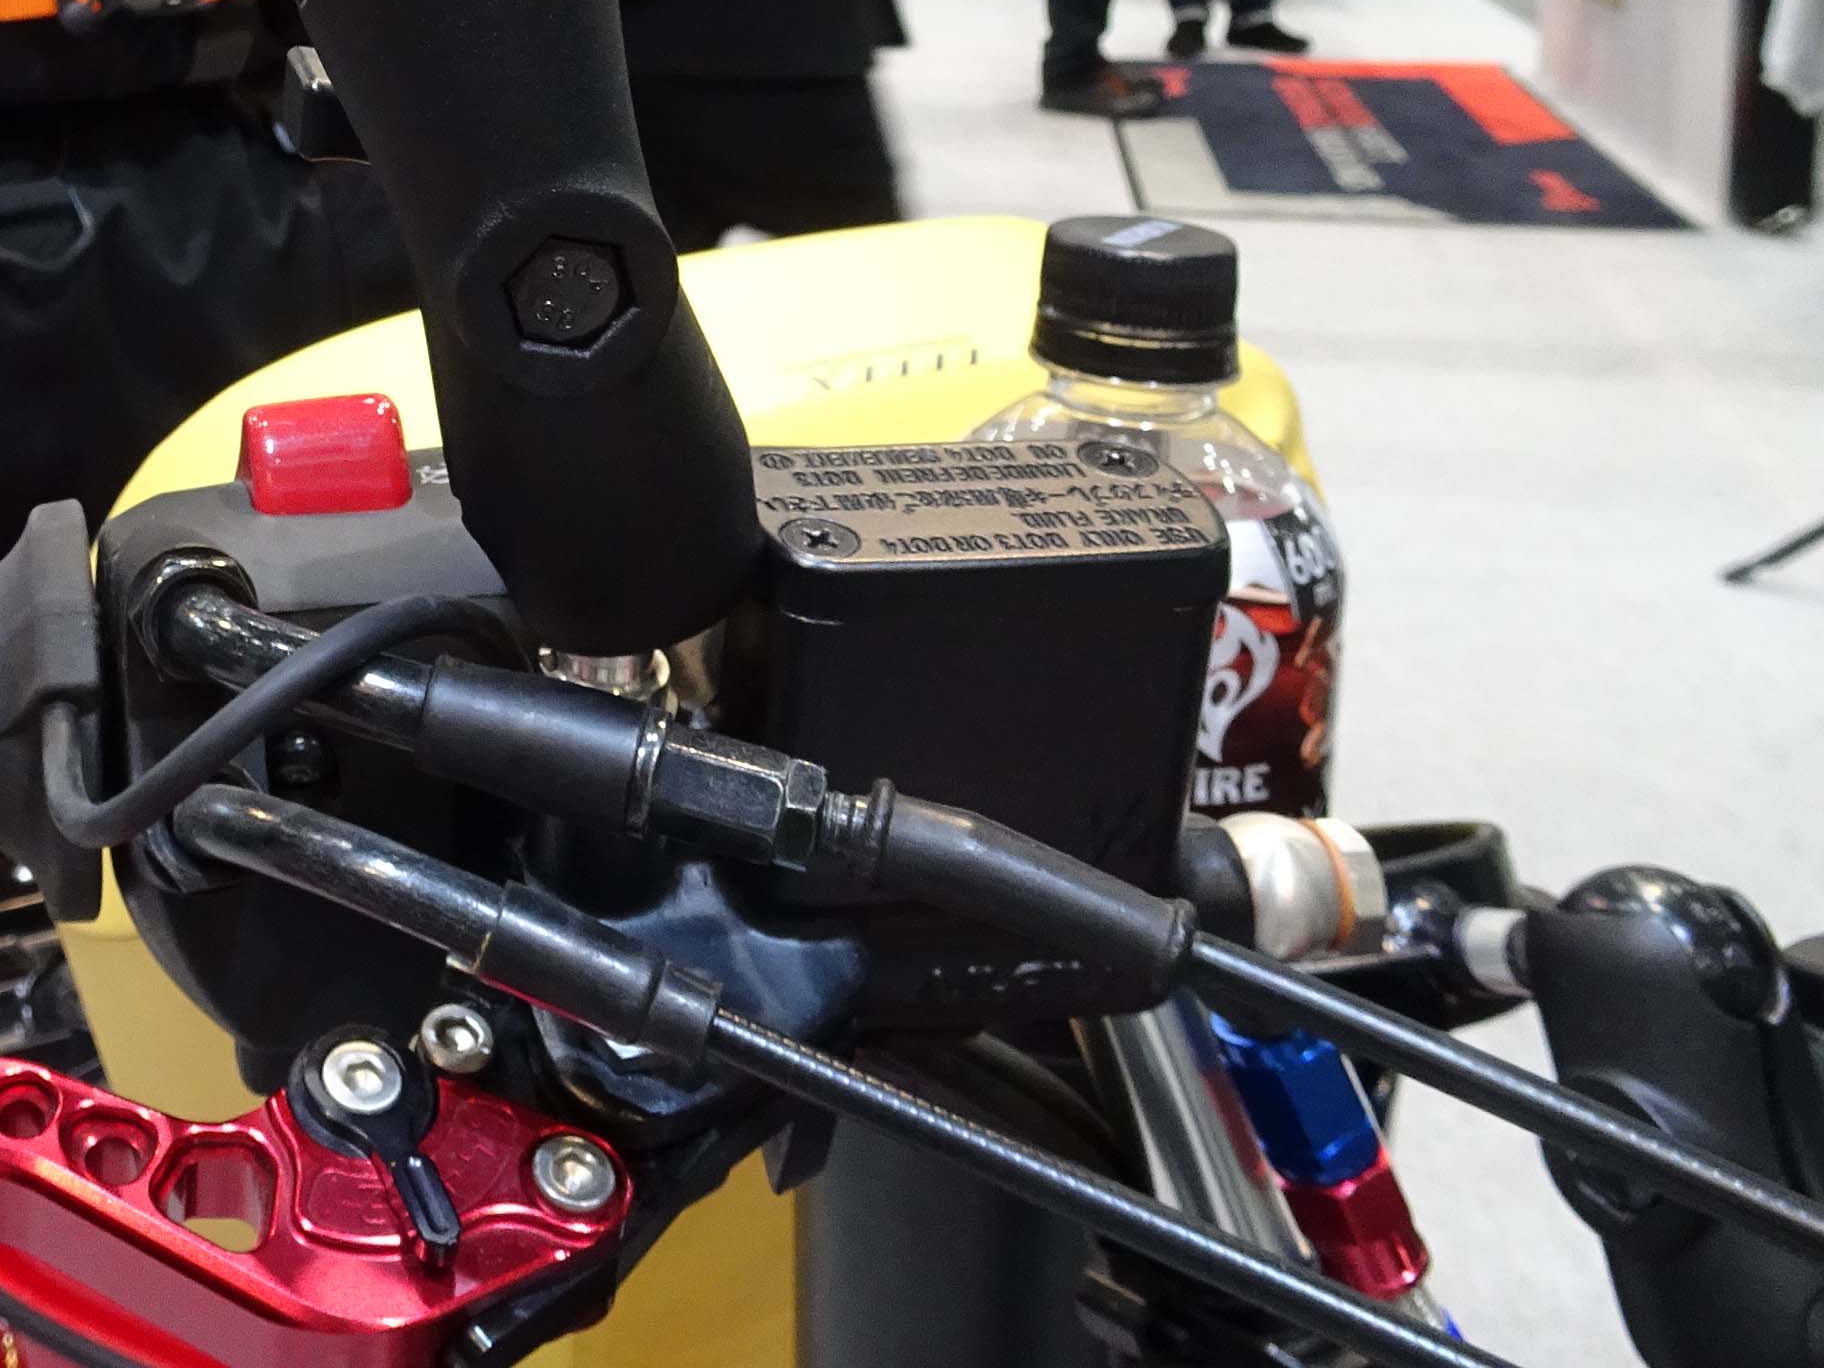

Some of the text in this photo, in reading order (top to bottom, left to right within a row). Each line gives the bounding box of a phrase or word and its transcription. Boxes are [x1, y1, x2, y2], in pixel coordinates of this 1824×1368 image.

[944, 446, 1016, 463] DOT4
[1094, 506, 1190, 528] BRAKE
[879, 526, 1211, 555] USE ONLY DOT3 OR DOT4
[1192, 761, 1272, 807] IRE
